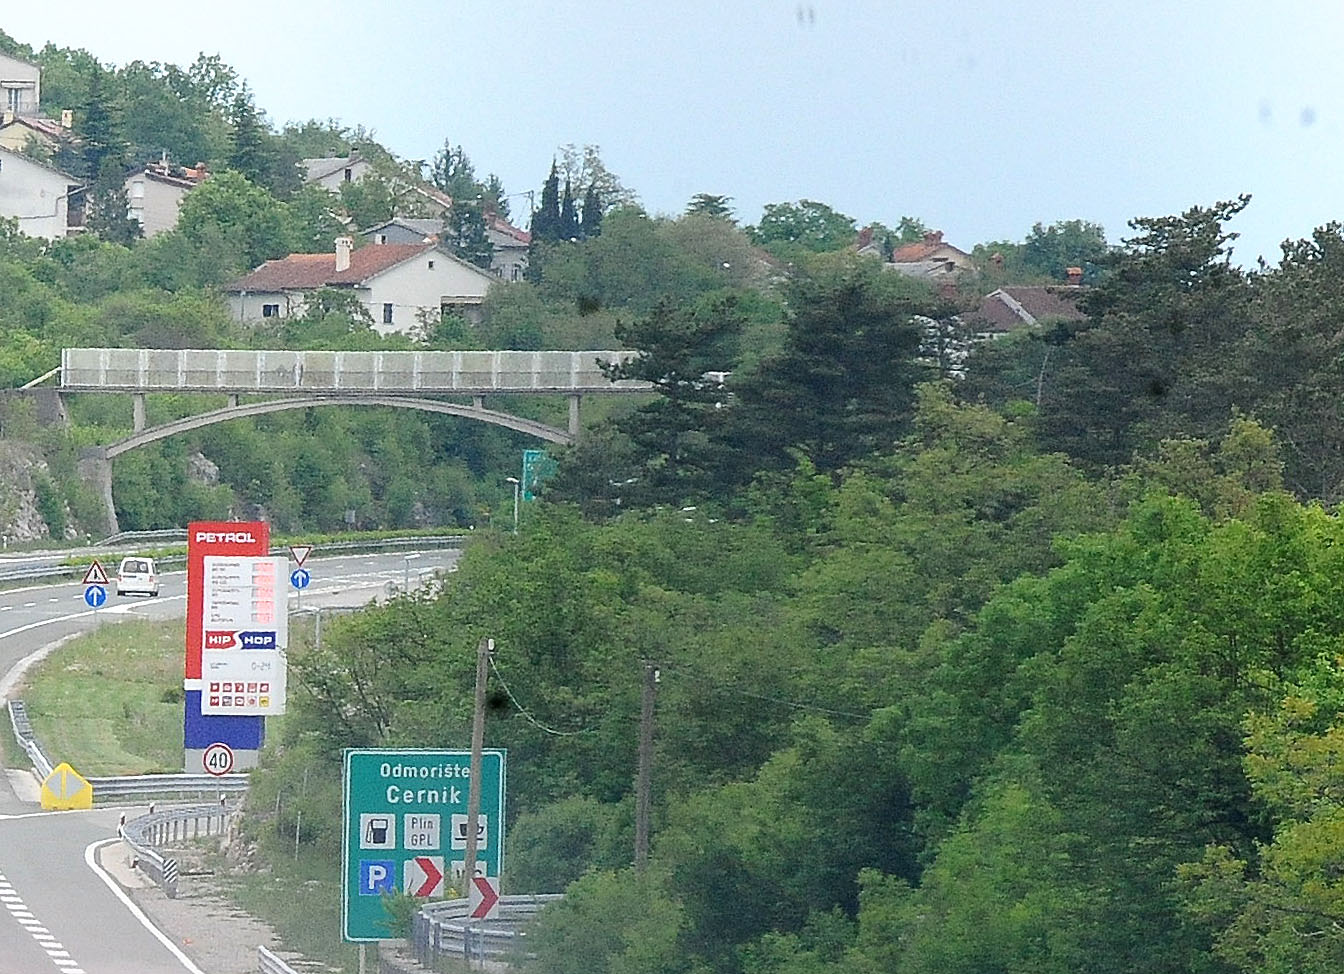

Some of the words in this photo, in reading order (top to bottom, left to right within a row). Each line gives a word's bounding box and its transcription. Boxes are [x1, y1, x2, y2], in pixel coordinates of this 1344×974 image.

[196, 532, 256, 543] PETROL
[209, 635, 232, 645] HIP
[244, 635, 273, 645] HOP
[209, 752, 228, 769] 40
[380, 762, 471, 778] Odmorište
[386, 785, 462, 804] Cernik
[411, 816, 434, 829] Plin
[411, 834, 433, 846] GPL
[368, 865, 387, 890] P
